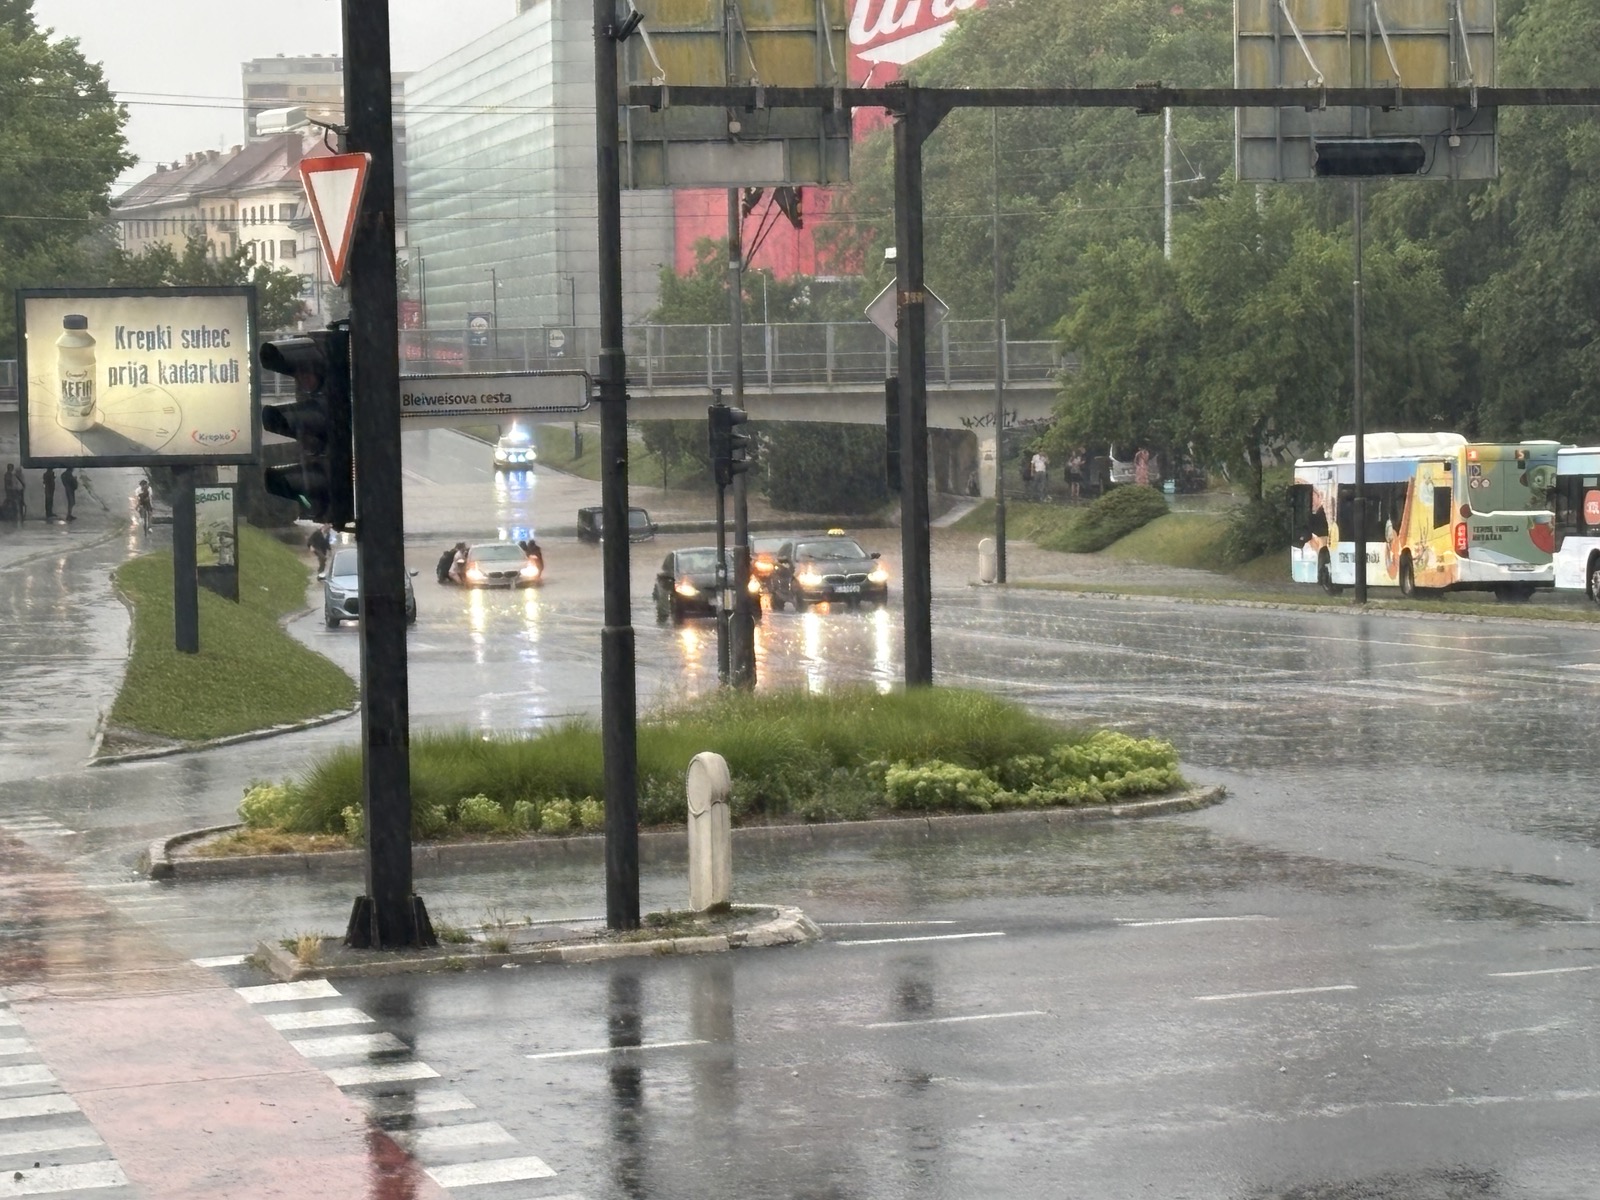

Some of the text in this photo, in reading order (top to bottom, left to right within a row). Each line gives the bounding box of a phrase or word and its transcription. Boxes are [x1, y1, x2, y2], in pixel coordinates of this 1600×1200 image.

[115, 325, 231, 352] Krepki suhec
[108, 358, 240, 387] prija kadarkoli
[402, 392, 512, 407] Bleiweisova cesta
